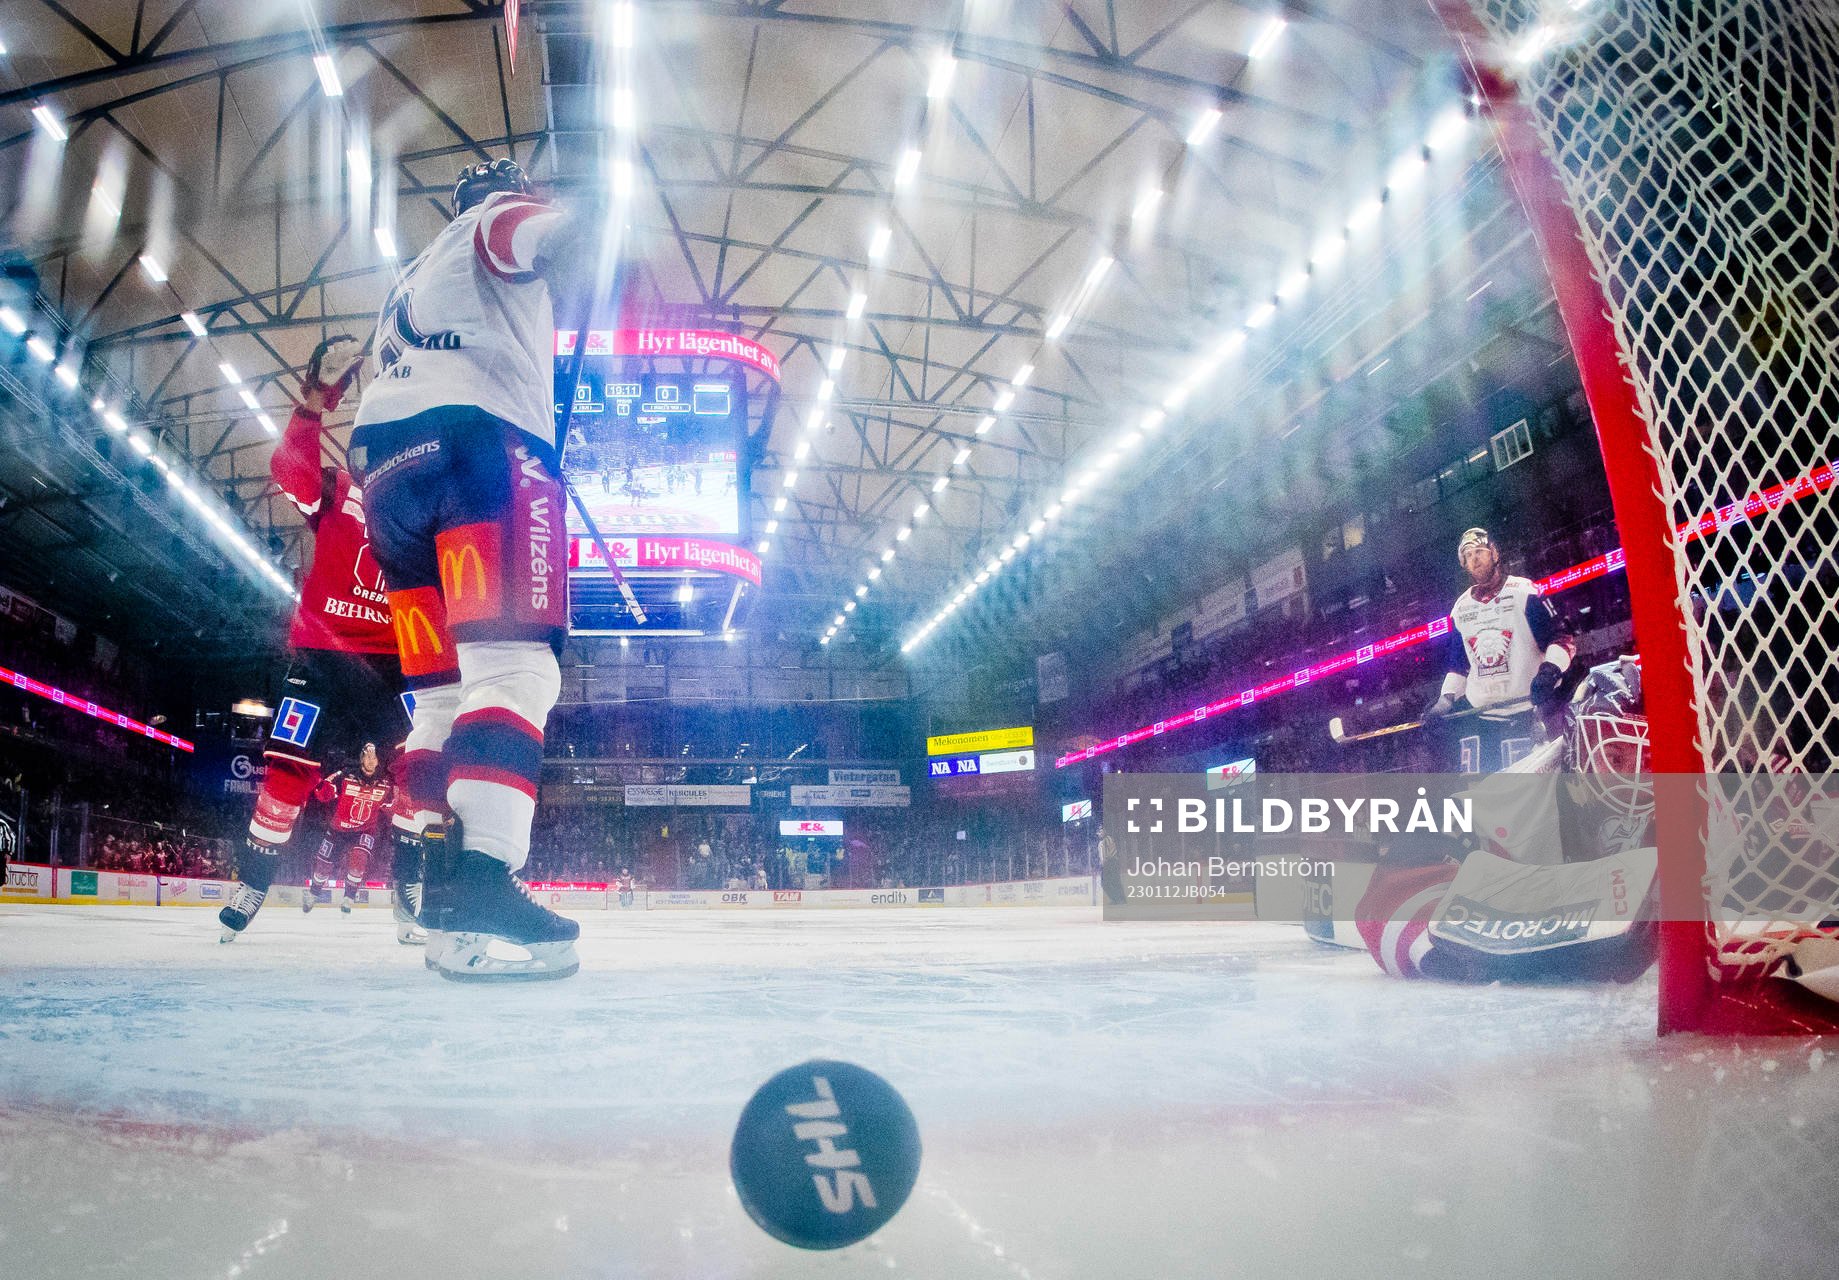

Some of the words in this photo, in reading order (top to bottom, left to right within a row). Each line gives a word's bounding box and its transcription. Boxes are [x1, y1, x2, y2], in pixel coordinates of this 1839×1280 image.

[639, 332, 675, 354] Hyr
[680, 331, 759, 362] lägenhet
[661, 389, 669, 400] 0
[530, 497, 552, 610] wilzéns
[645, 541, 680, 564] Hyr
[684, 540, 749, 573] lägenhet
[933, 734, 989, 747] Mekonomen
[931, 762, 951, 775] NA
[957, 759, 977, 772] NA
[722, 893, 747, 903] OBK
[1611, 868, 1628, 917] CCM
[785, 1075, 878, 1214] SHL
